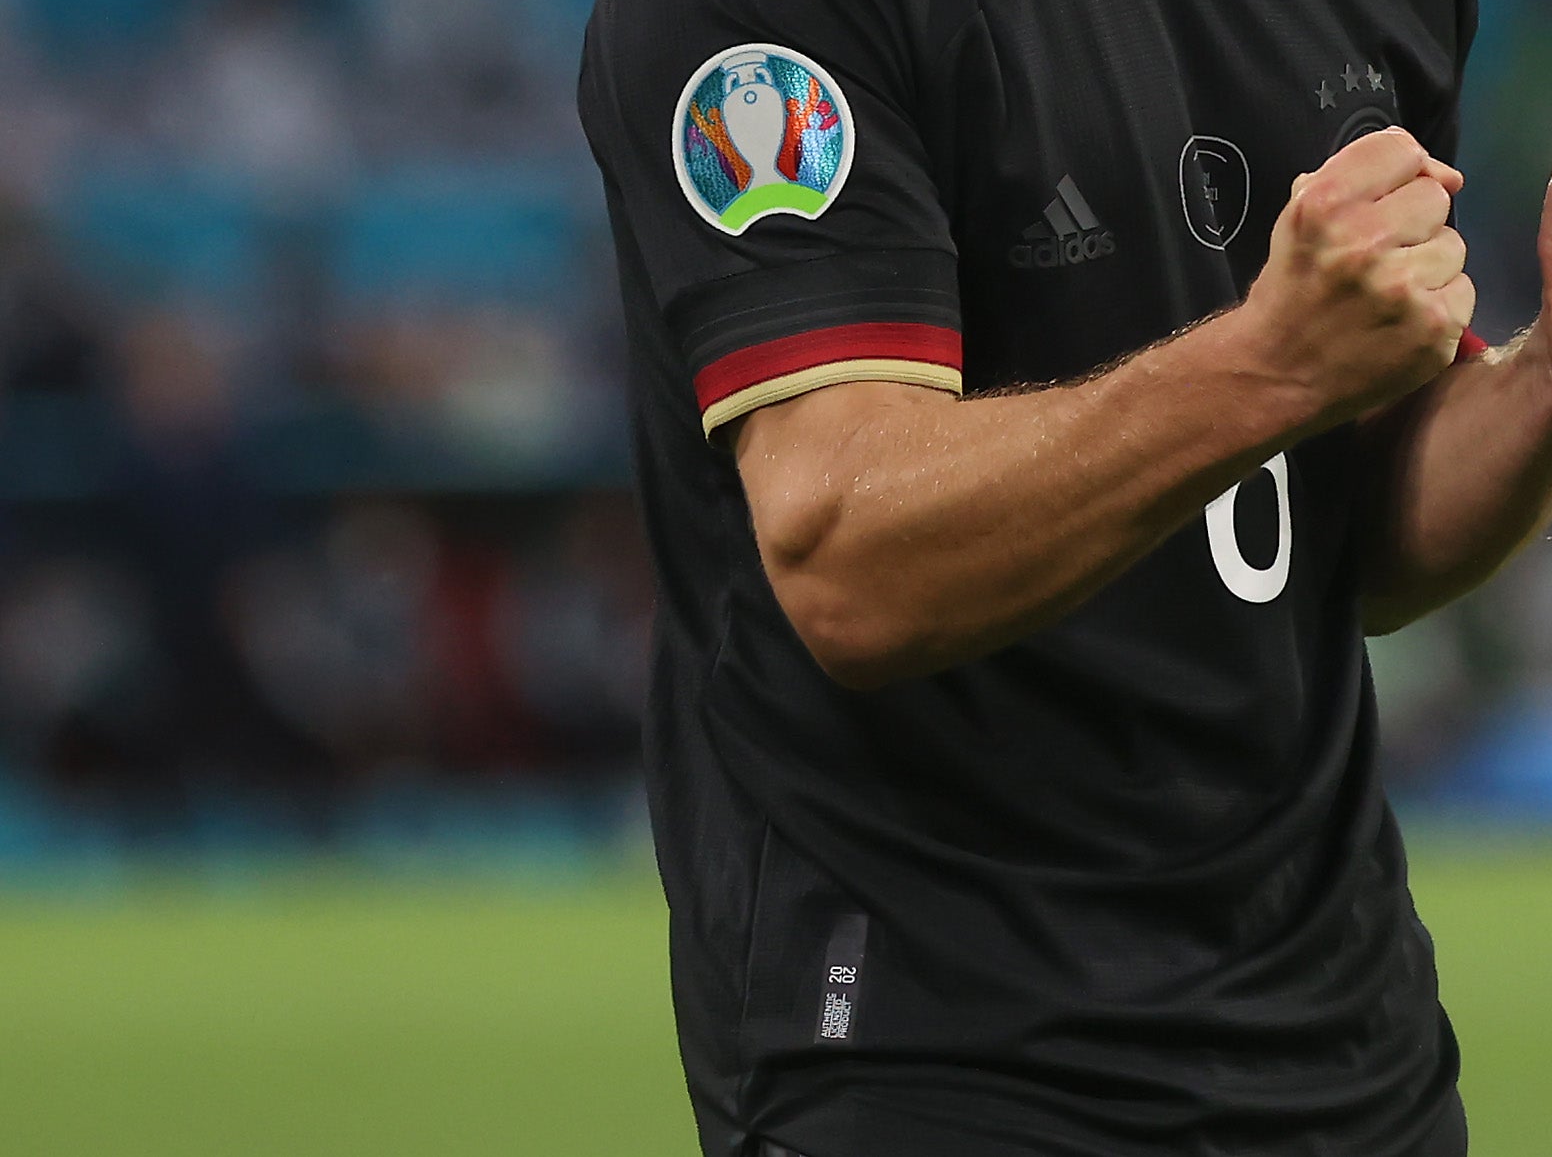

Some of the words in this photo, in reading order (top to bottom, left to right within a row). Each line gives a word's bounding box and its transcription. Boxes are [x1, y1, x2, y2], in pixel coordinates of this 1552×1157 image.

[1008, 230, 1117, 268] adidas
[829, 966, 843, 984] 20
[820, 993, 835, 1038] AUTHENTIC
[830, 999, 844, 1038] LICENSED
[838, 1001, 852, 1039] PRODUCT
